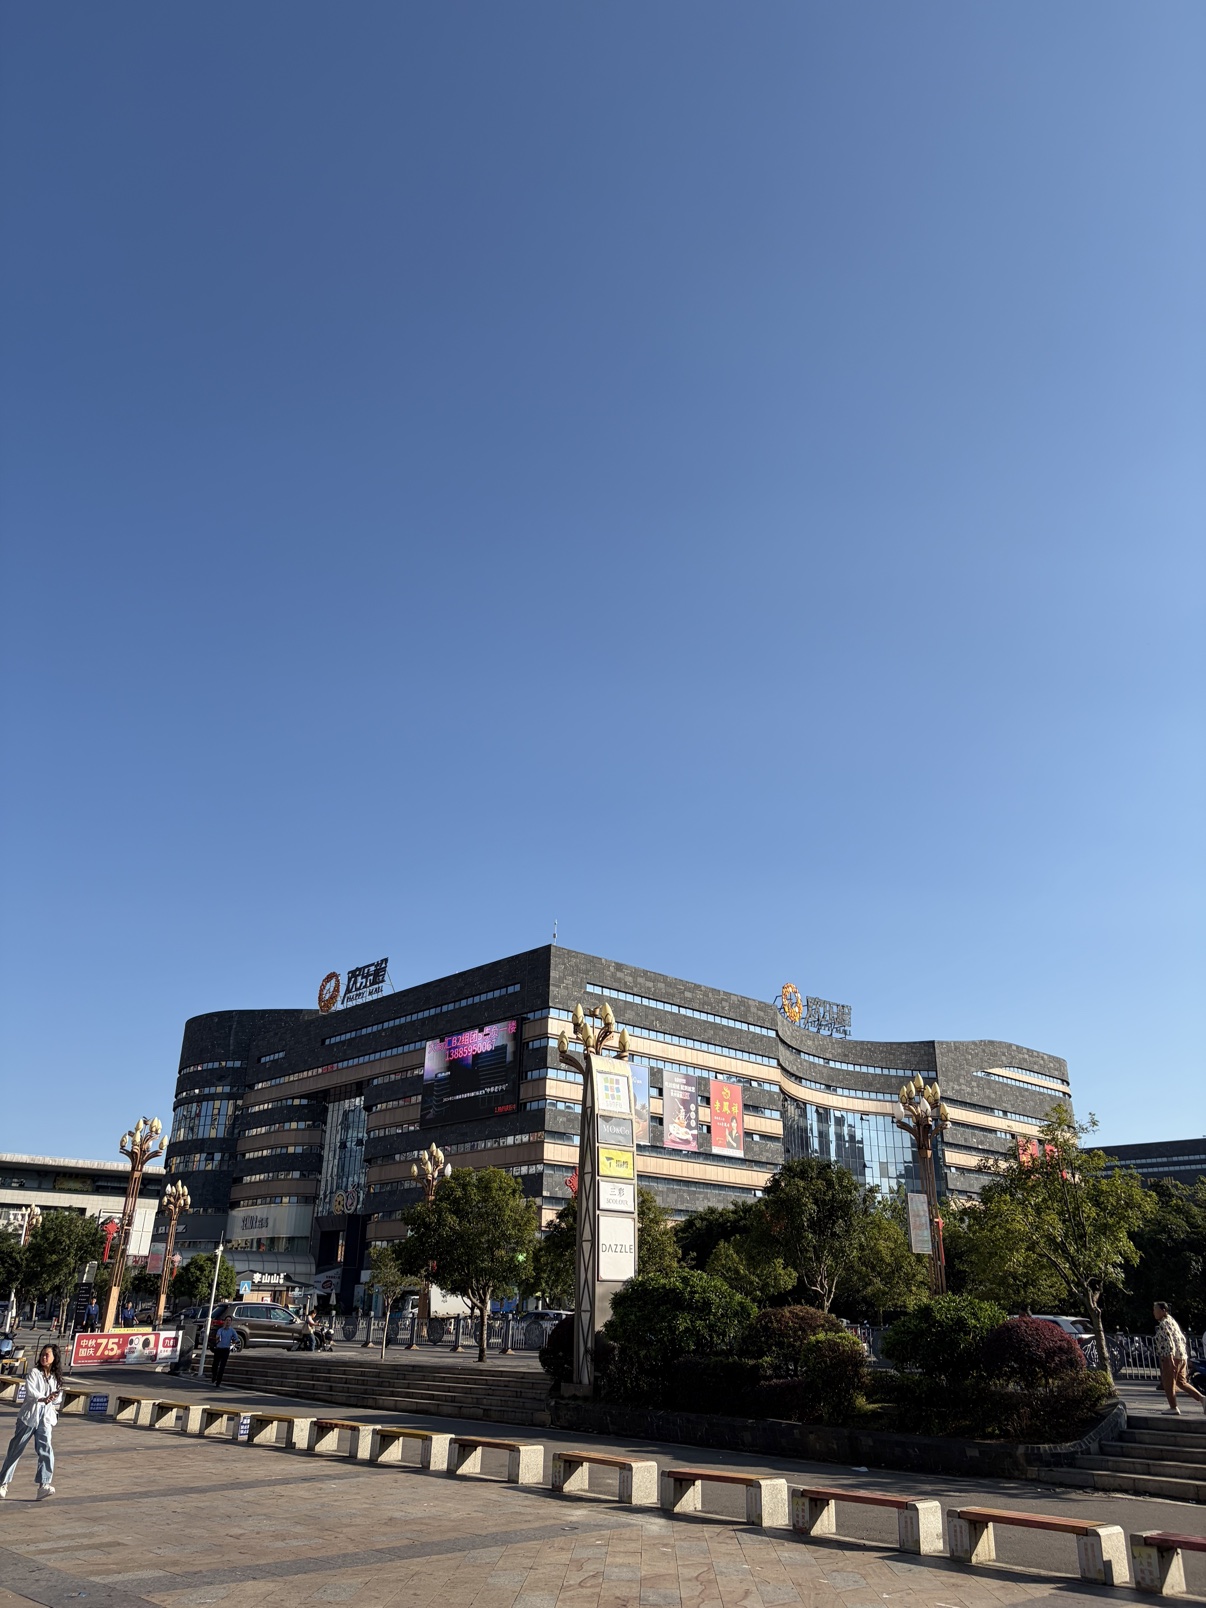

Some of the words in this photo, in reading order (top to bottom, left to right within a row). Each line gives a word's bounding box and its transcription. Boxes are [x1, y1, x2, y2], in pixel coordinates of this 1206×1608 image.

[445, 1039, 496, 1062] 13885950067
[609, 1187, 625, 1198] 三彩
[601, 1243, 634, 1254] DAZZLE
[80, 1338, 96, 1347] 中秋
[79, 1348, 95, 1357] 国庆
